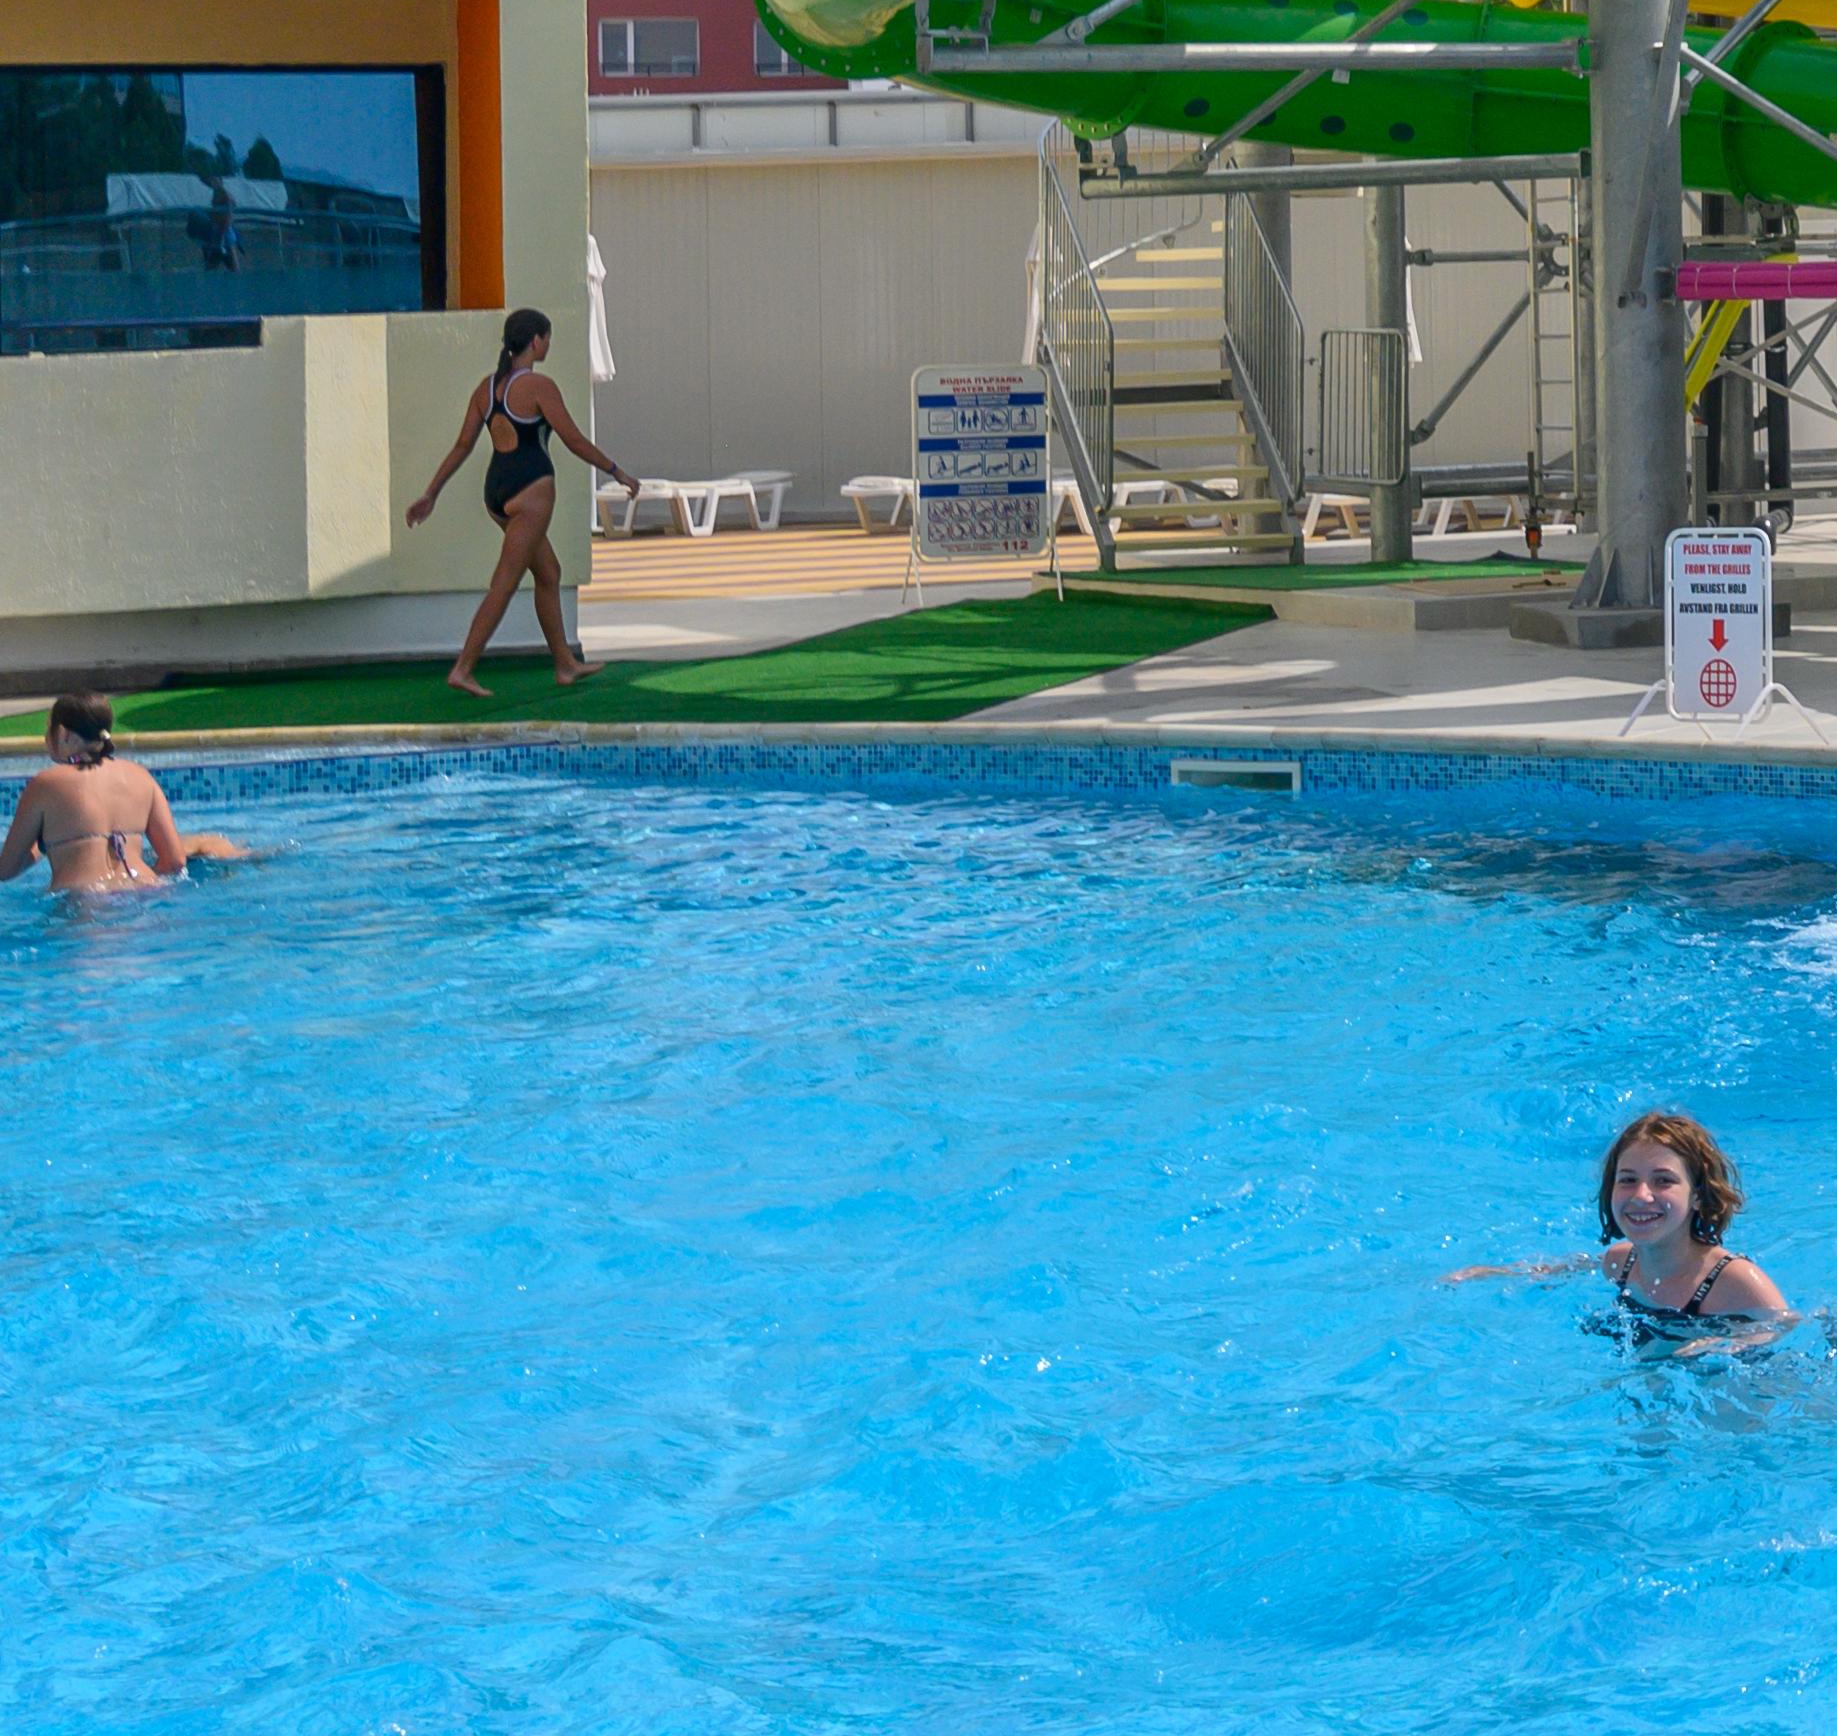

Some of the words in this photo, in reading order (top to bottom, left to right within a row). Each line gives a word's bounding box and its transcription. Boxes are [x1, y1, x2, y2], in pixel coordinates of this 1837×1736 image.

[1002, 540, 1029, 551] 112
[1712, 544, 1729, 555] STAY
[1731, 544, 1752, 555] AWAY
[1684, 563, 1706, 575] FROM
[1707, 563, 1721, 575] THE
[1722, 563, 1751, 575] GRILLES
[1728, 583, 1747, 594] HOLD
[1680, 602, 1713, 614] AVSTAND
[1714, 603, 1728, 614] FRA
[1729, 603, 1758, 614] GRILLEN
